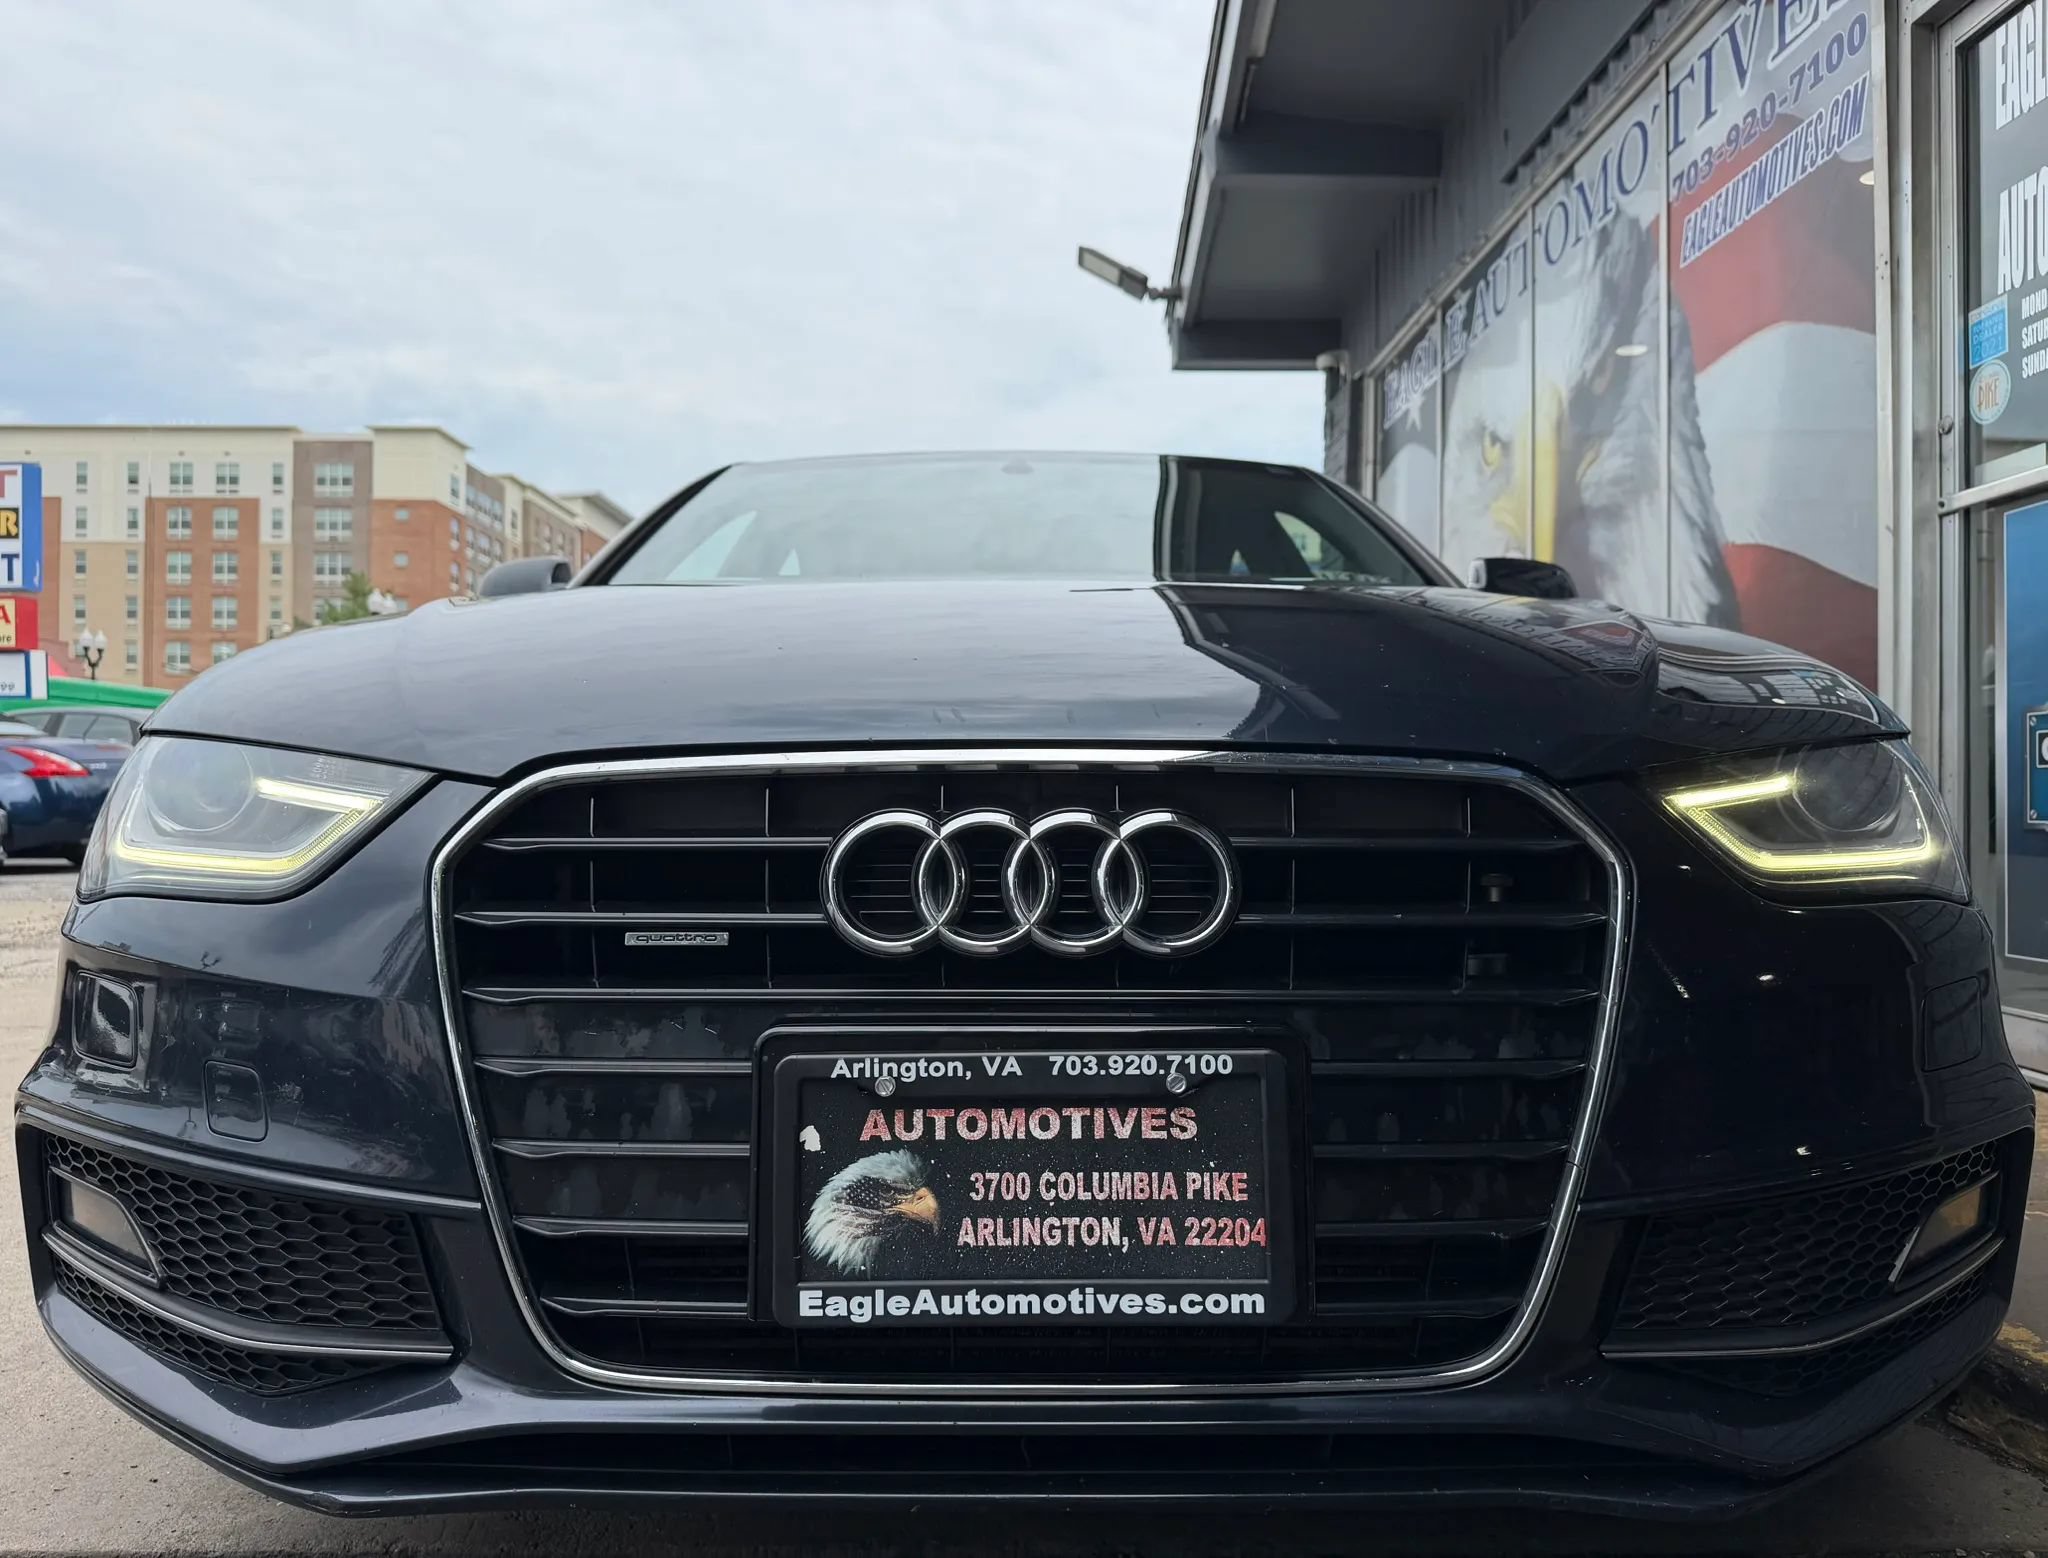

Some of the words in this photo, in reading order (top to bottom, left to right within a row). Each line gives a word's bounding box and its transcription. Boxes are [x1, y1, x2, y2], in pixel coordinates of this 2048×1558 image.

[1996, 0, 2048, 130] EAGL
[1673, 13, 1867, 204] 703-920-7100
[1470, 0, 1861, 346] AUTOMOTIVE
[1680, 71, 1869, 267] EAGLEAUTOMOTIVES.COM
[636, 933, 718, 944] quattro
[831, 1056, 971, 1083] Arlington,
[982, 1056, 1023, 1077] VA
[1049, 1054, 1233, 1077] 703.920.7100
[859, 1107, 1198, 1142] AUTOMOTIVES
[969, 1171, 1031, 1201] 3700
[1038, 1171, 1178, 1201] COLUMBIA
[1185, 1171, 1249, 1201] PIKE
[957, 1216, 1129, 1254] ARLINGTON,
[1137, 1216, 1176, 1246] VA
[1184, 1216, 1267, 1247] 22204
[799, 1288, 1266, 1323] EagleAutomotives.com
